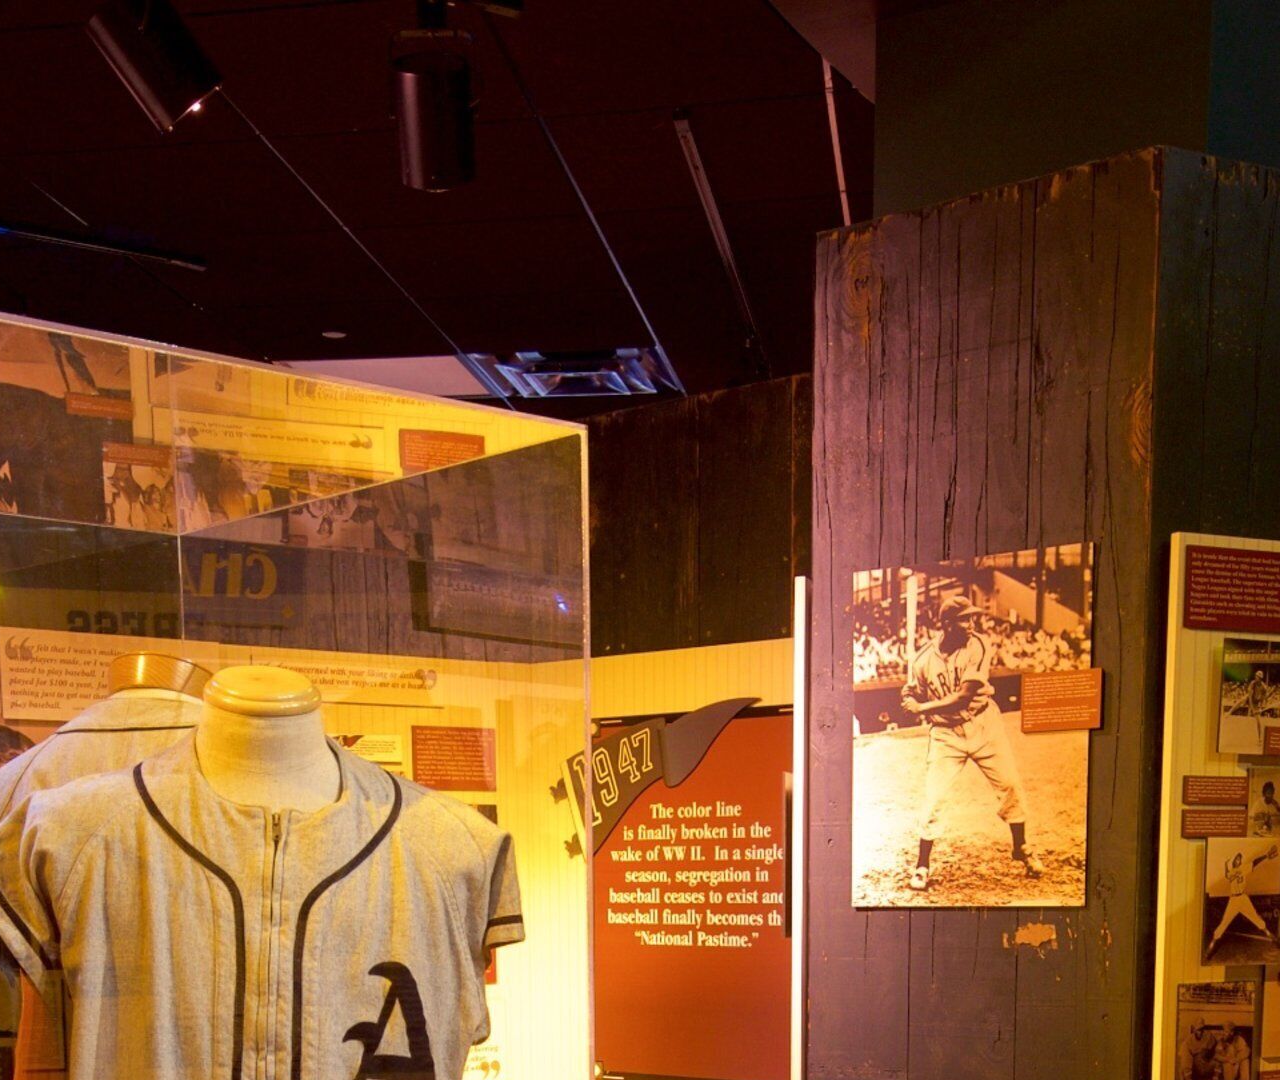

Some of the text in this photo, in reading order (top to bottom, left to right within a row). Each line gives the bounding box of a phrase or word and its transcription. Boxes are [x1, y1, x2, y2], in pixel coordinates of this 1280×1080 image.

[36, 643, 97, 655] felt that wasn't
[31, 656, 58, 667] players
[9, 665, 97, 678] wanted play baseball.
[9, 675, 68, 688] played $100
[10, 688, 39, 700] nothing
[28, 701, 61, 710] baseball.
[573, 727, 654, 827] 1947
[650, 801, 742, 819] The color line
[623, 821, 772, 844] is finally broken in the
[611, 848, 642, 862] wake
[646, 846, 661, 861] of
[663, 846, 687, 861] WW
[690, 846, 706, 862] II.
[714, 846, 729, 861] In
[732, 849, 741, 860] a
[625, 867, 769, 886] season, segregation in
[609, 888, 758, 904] baseball ceases to exist
[607, 908, 782, 929] baseball finally becomes th
[634, 930, 759, 948] “National Pastime.”
